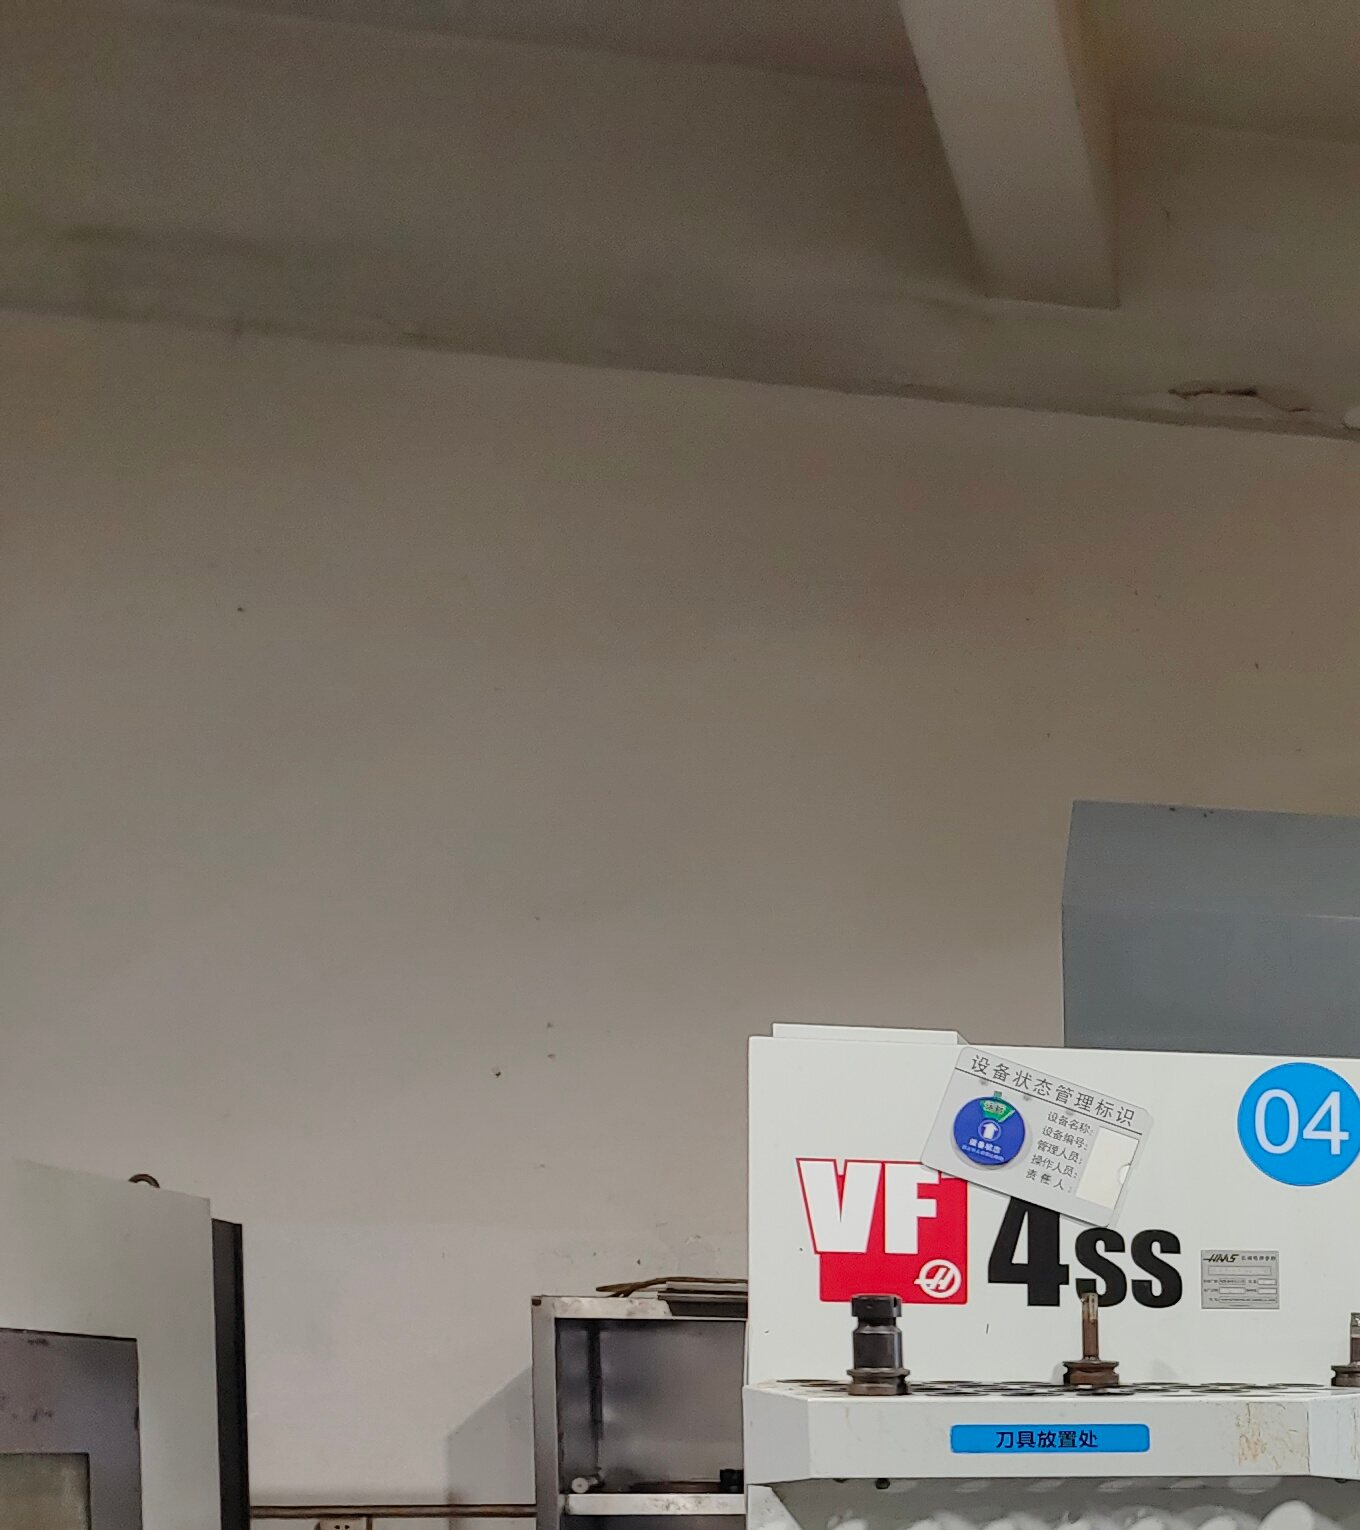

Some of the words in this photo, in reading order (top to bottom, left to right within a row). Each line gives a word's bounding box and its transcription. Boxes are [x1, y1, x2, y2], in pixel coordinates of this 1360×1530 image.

[971, 1054, 1135, 1127] 设备状态管理标识
[1253, 1088, 1350, 1156] 04
[797, 1158, 942, 1255] VF
[995, 1429, 1098, 1449] 刀具放置处
